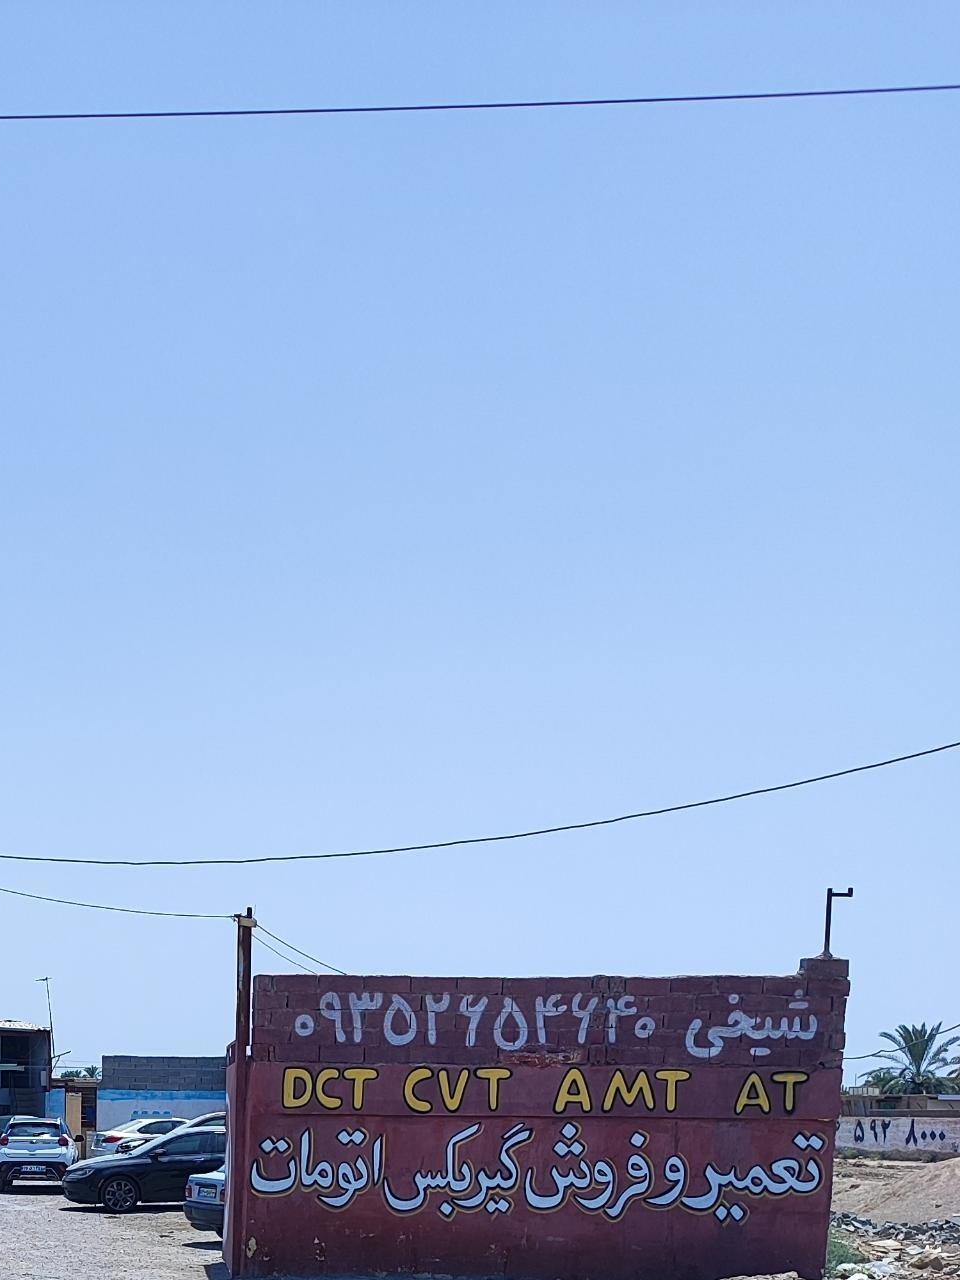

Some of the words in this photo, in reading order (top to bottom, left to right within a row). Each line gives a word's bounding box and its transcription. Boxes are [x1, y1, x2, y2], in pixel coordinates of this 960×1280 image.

[294, 991, 656, 1051] ۰۹۳۵۲۶۵۴۶۴۰
[282, 1067, 378, 1110] DCT
[403, 1067, 512, 1113] CVT
[553, 1067, 691, 1114] AMT
[734, 1071, 809, 1115] AT
[250, 1127, 383, 1208] اتومات
[384, 1122, 534, 1216] گیربکس
[525, 1122, 650, 1218] فروش
[644, 1153, 686, 1206] و
[681, 1132, 825, 1222] تعمیر
